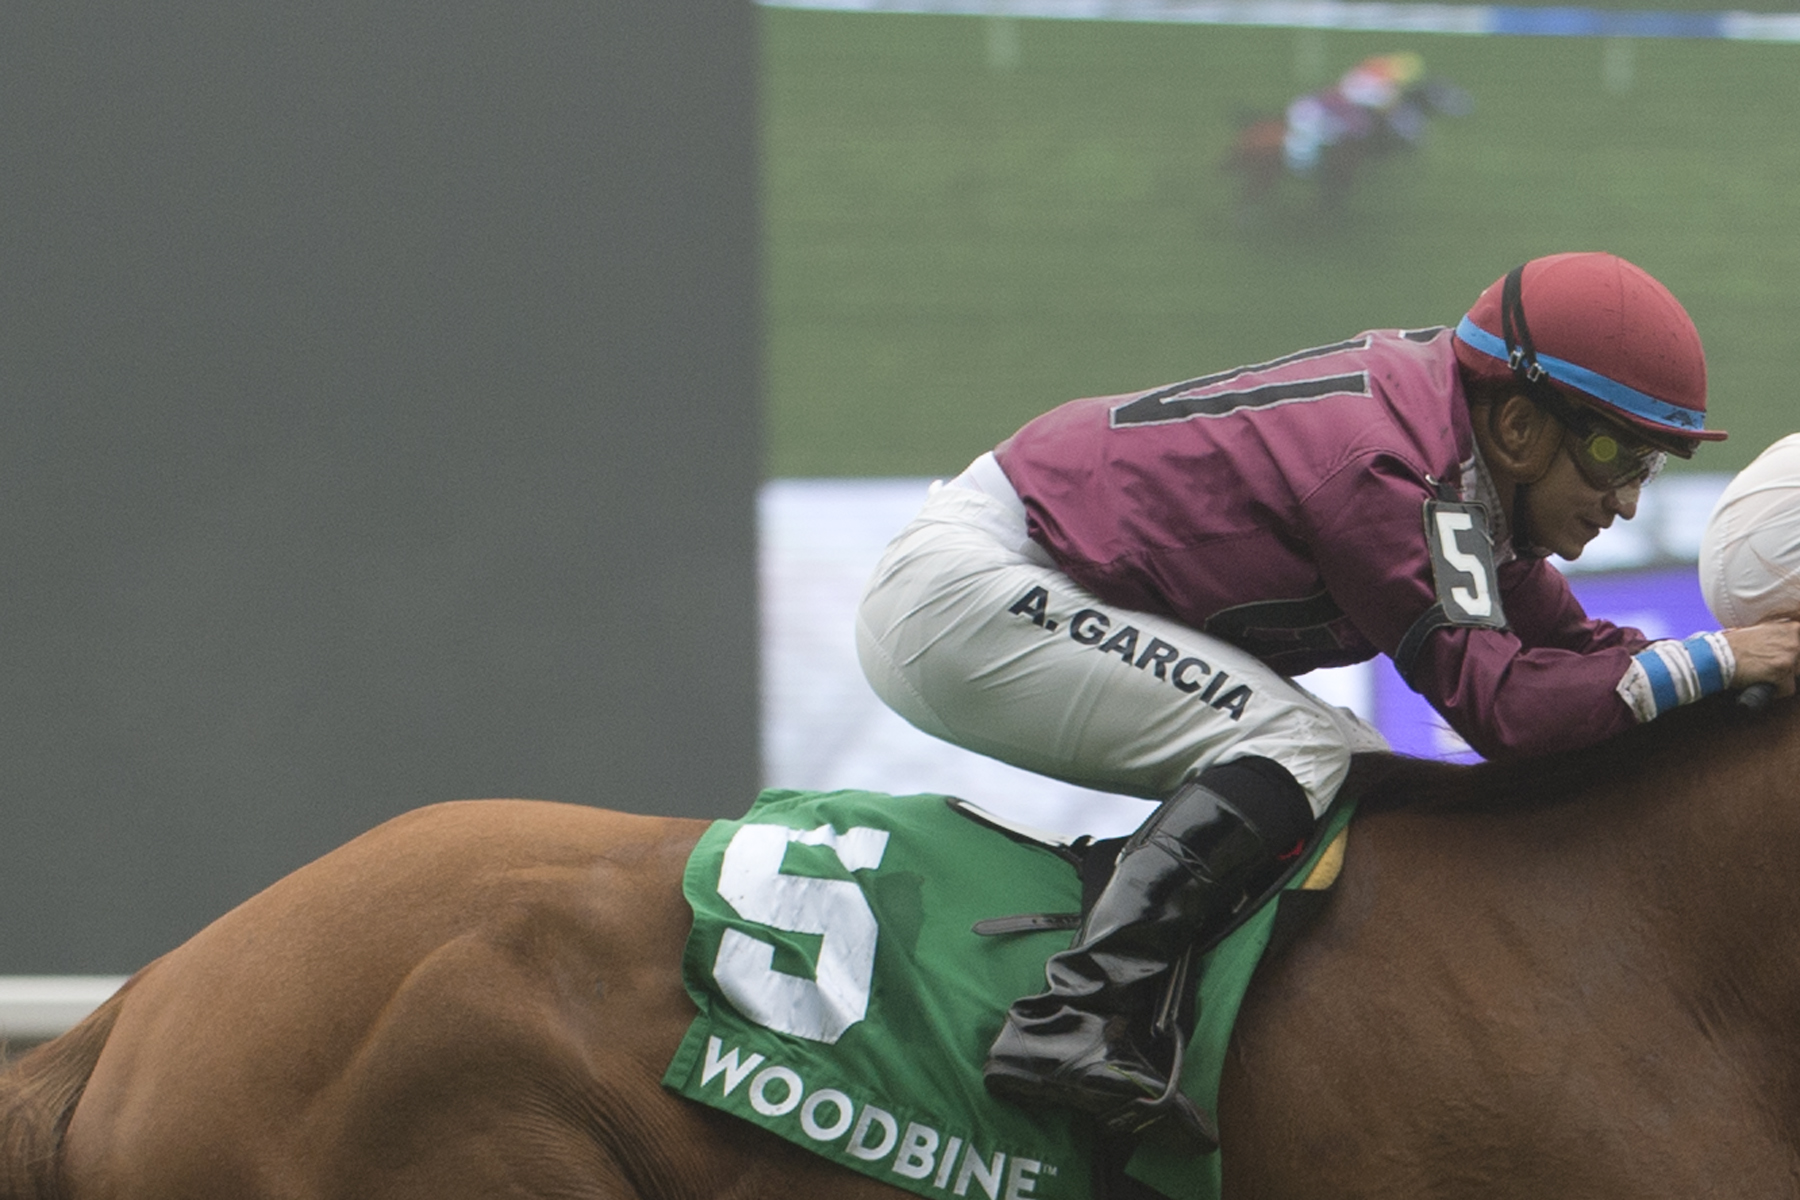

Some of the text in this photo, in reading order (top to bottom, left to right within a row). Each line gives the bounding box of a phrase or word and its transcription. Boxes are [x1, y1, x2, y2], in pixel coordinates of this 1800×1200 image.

[1435, 511, 1492, 617] 5
[1068, 606, 1255, 722] GARCIA
[712, 823, 891, 1046] 5
